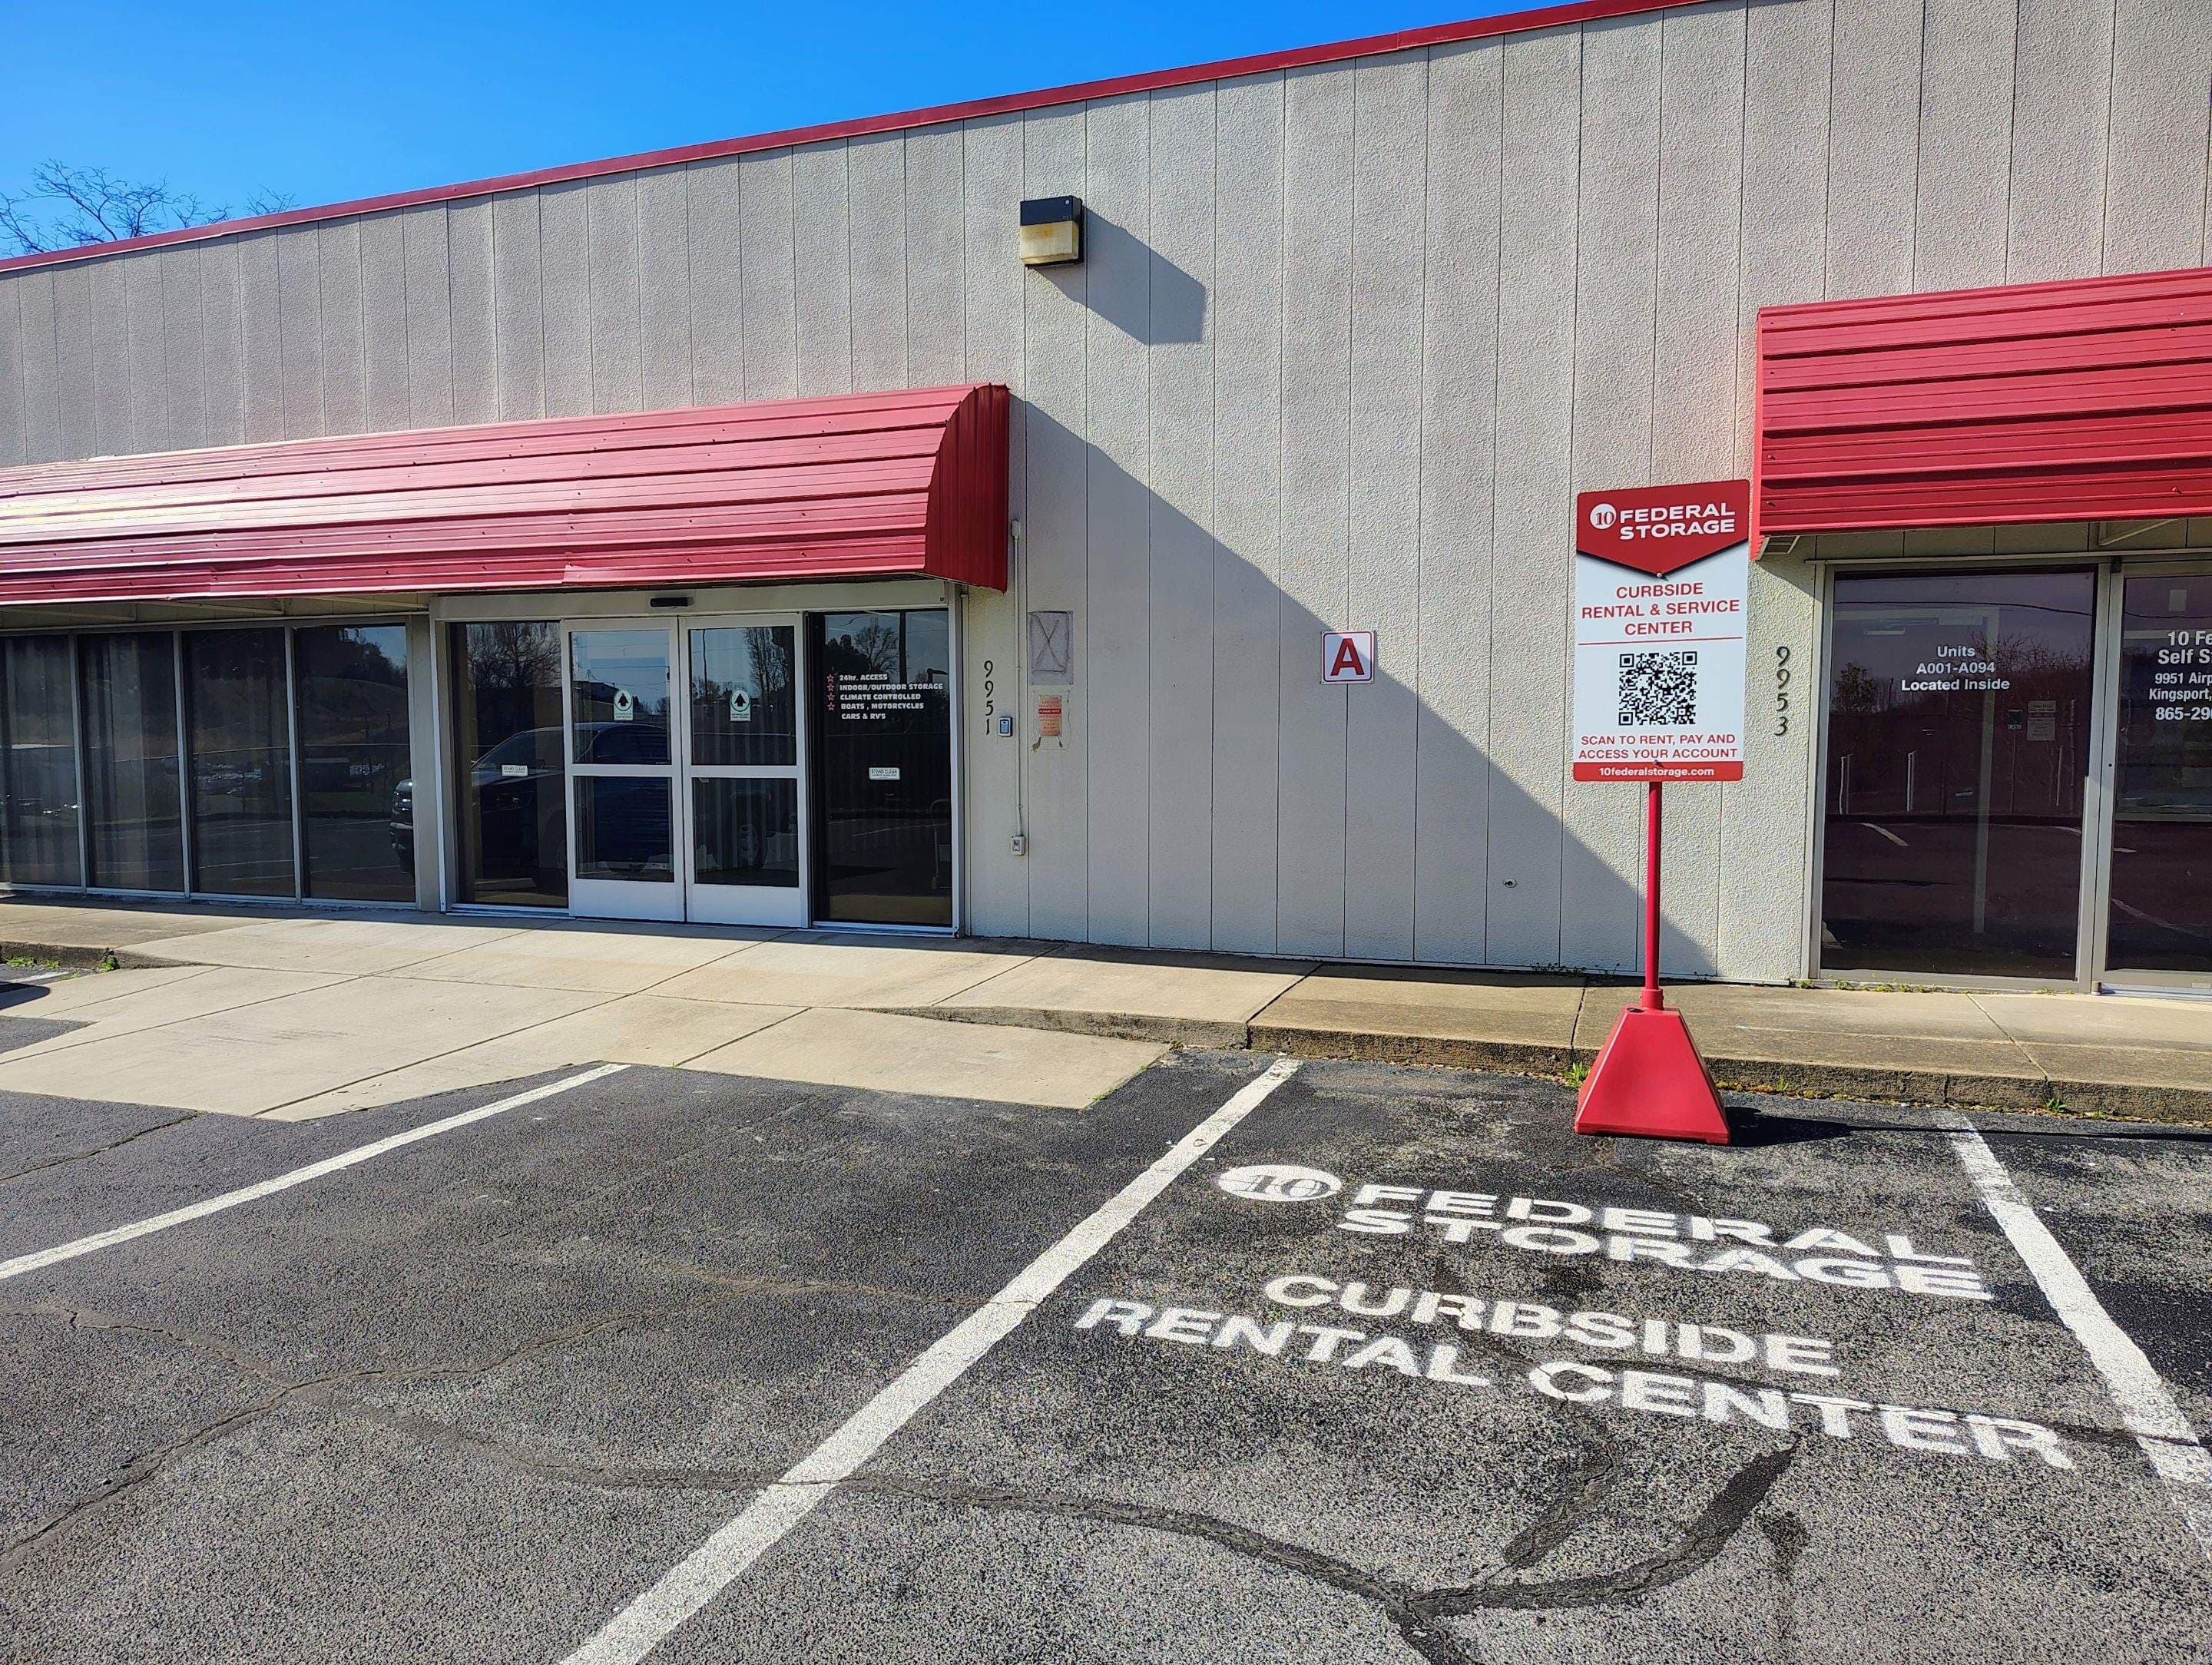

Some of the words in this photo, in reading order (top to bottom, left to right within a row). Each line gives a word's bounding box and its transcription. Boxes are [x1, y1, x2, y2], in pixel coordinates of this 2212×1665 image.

[1594, 511, 1614, 525] 10
[1620, 502, 1736, 523] FEDERAL
[1619, 519, 1736, 540] STORAGE
[1616, 583, 1703, 598] CURBSIDE
[1581, 605, 1645, 619] RENTAL
[1650, 604, 1661, 616] &
[1666, 599, 1740, 614] SERVICE
[1624, 621, 1693, 635] CENTER
[2167, 631, 2190, 646] 10
[1330, 637, 1366, 676] A
[1937, 645, 1976, 657] Units
[2157, 649, 2194, 664] Self
[2198, 648, 2212, 664] S
[1916, 661, 1995, 674] A001-A094
[1901, 679, 1960, 691] Located
[1965, 678, 2011, 690] Inside
[2154, 672, 2184, 684] 9951
[983, 660, 994, 736] 9951
[1774, 646, 1790, 736] 9953
[2149, 688, 2212, 702] Kingsport,
[2155, 707, 2212, 720] 865-29
[1581, 735, 1615, 746] SCAN
[1618, 735, 1636, 745] TO
[1639, 734, 1675, 746] RENT,
[1679, 734, 1704, 744] PAY
[1707, 734, 1736, 744] AND
[1578, 750, 1629, 759] ACCESS
[1632, 749, 1668, 759] YOUR
[1672, 748, 1738, 758] ACCOUNT
[1599, 767, 1714, 777] 10federalstorage.com
[1238, 1174, 1331, 1199] 10
[1353, 1183, 1974, 1266] FEDERAL
[1336, 1210, 1995, 1300] STORAGE
[1263, 1275, 1841, 1376] CURBSIDE
[1075, 1298, 1491, 1385] RENTAL
[1528, 1360, 2075, 1469] CENTER
